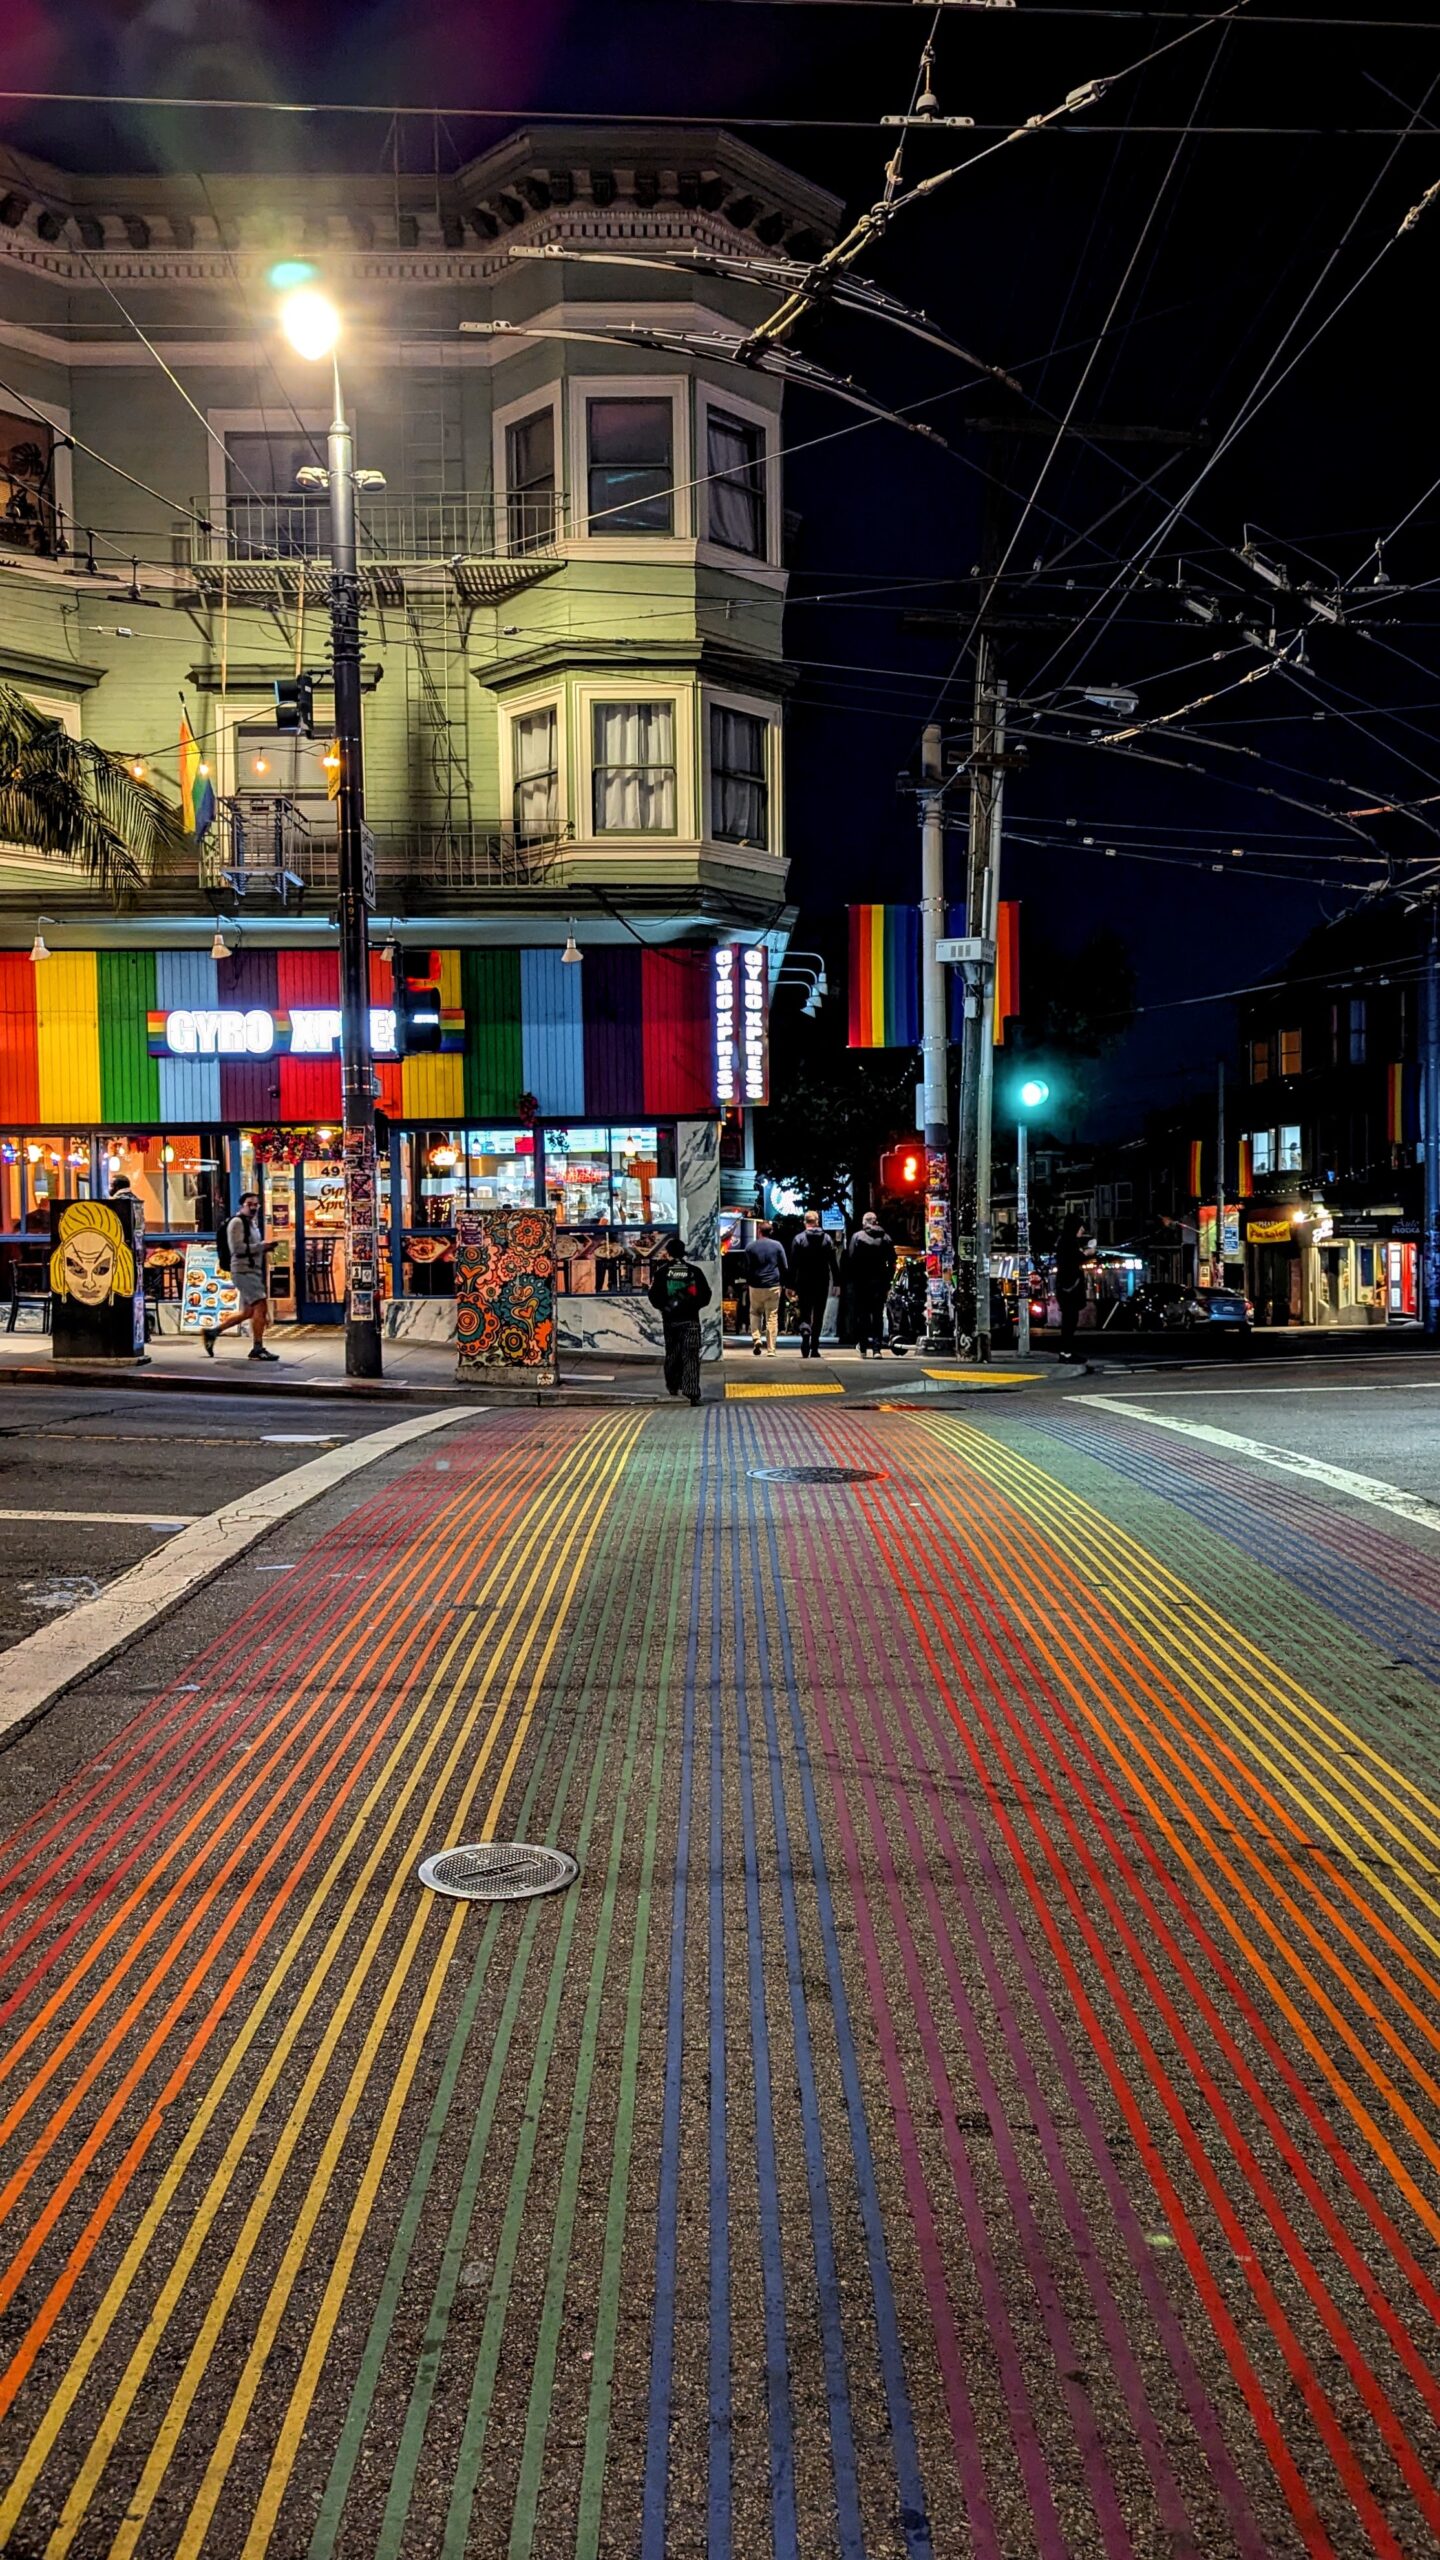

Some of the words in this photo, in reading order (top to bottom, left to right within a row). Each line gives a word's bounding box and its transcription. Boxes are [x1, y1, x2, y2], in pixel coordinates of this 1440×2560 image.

[363, 864, 375, 898] 20
[166, 1010, 274, 1053] GYRO
[289, 1010, 397, 1053] XPE
[320, 1184, 344, 1198] Gyr
